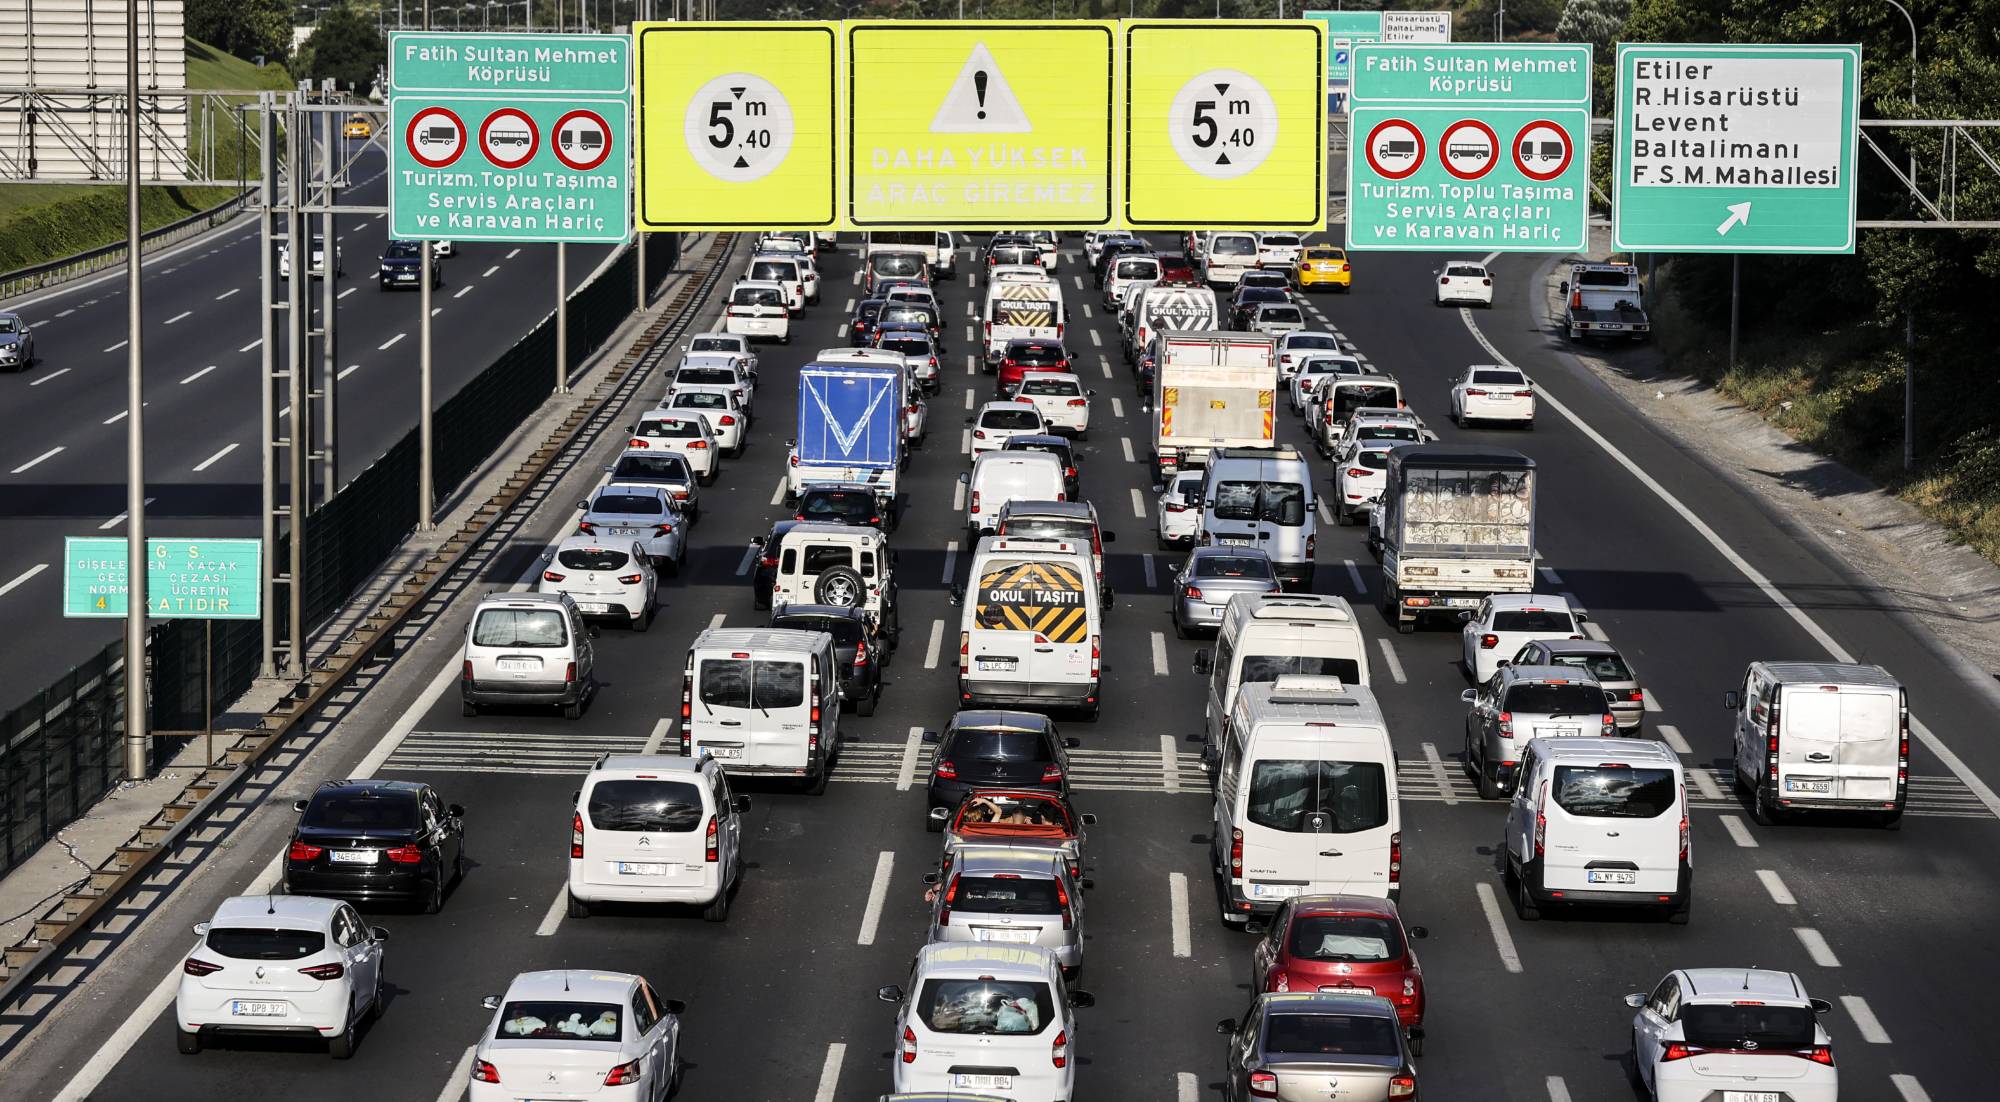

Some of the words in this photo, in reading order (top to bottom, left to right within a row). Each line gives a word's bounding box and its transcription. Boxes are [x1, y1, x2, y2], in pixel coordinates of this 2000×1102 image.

[405, 45, 457, 61] Fatih
[463, 46, 529, 62] Sultan
[534, 47, 618, 63] Mehmet
[1366, 55, 1417, 72] Fatih
[1423, 56, 1489, 73] Sultan
[1495, 57, 1577, 73] Mehmet
[1636, 61, 1713, 80] Etiler
[468, 65, 550, 85] Köprüsü
[1430, 75, 1512, 95] Köprüsü
[745, 101, 766, 116] m
[1229, 100, 1250, 115] m
[1635, 113, 1729, 132] Levent
[871, 147, 957, 169] DAHA
[967, 143, 1088, 169] YÜKSEK
[1634, 139, 1798, 158] Baltalimanı
[481, 171, 537, 191] Toplu
[543, 172, 618, 190] Taşıma
[963, 179, 1096, 205] GİREMEZ
[1440, 184, 1495, 203] Toplu
[1501, 185, 1574, 202] Taşıma
[428, 193, 497, 209] Servis
[504, 193, 594, 212] Araçları
[1387, 203, 1456, 219] Servis
[1464, 204, 1551, 222] Araçları
[416, 215, 441, 228] ve
[448, 213, 538, 229] Karavan
[545, 214, 604, 231] Hariç
[1374, 225, 1398, 238] ve
[1406, 223, 1494, 239] Karavan
[1503, 224, 1561, 242] Hariç
[1152, 308, 1178, 316] OKUL
[78, 558, 167, 571] GİŞELEEN
[187, 561, 239, 572] KAÇAK
[96, 597, 107, 608] 4
[990, 590, 1025, 602] OKUL
[1035, 591, 1078, 605] TAŞITI
[623, 863, 633, 872] 34
[1592, 872, 1602, 881] 34
[1604, 873, 1614, 881] NY
[237, 1003, 248, 1013] 34
[961, 1075, 972, 1085] 34
